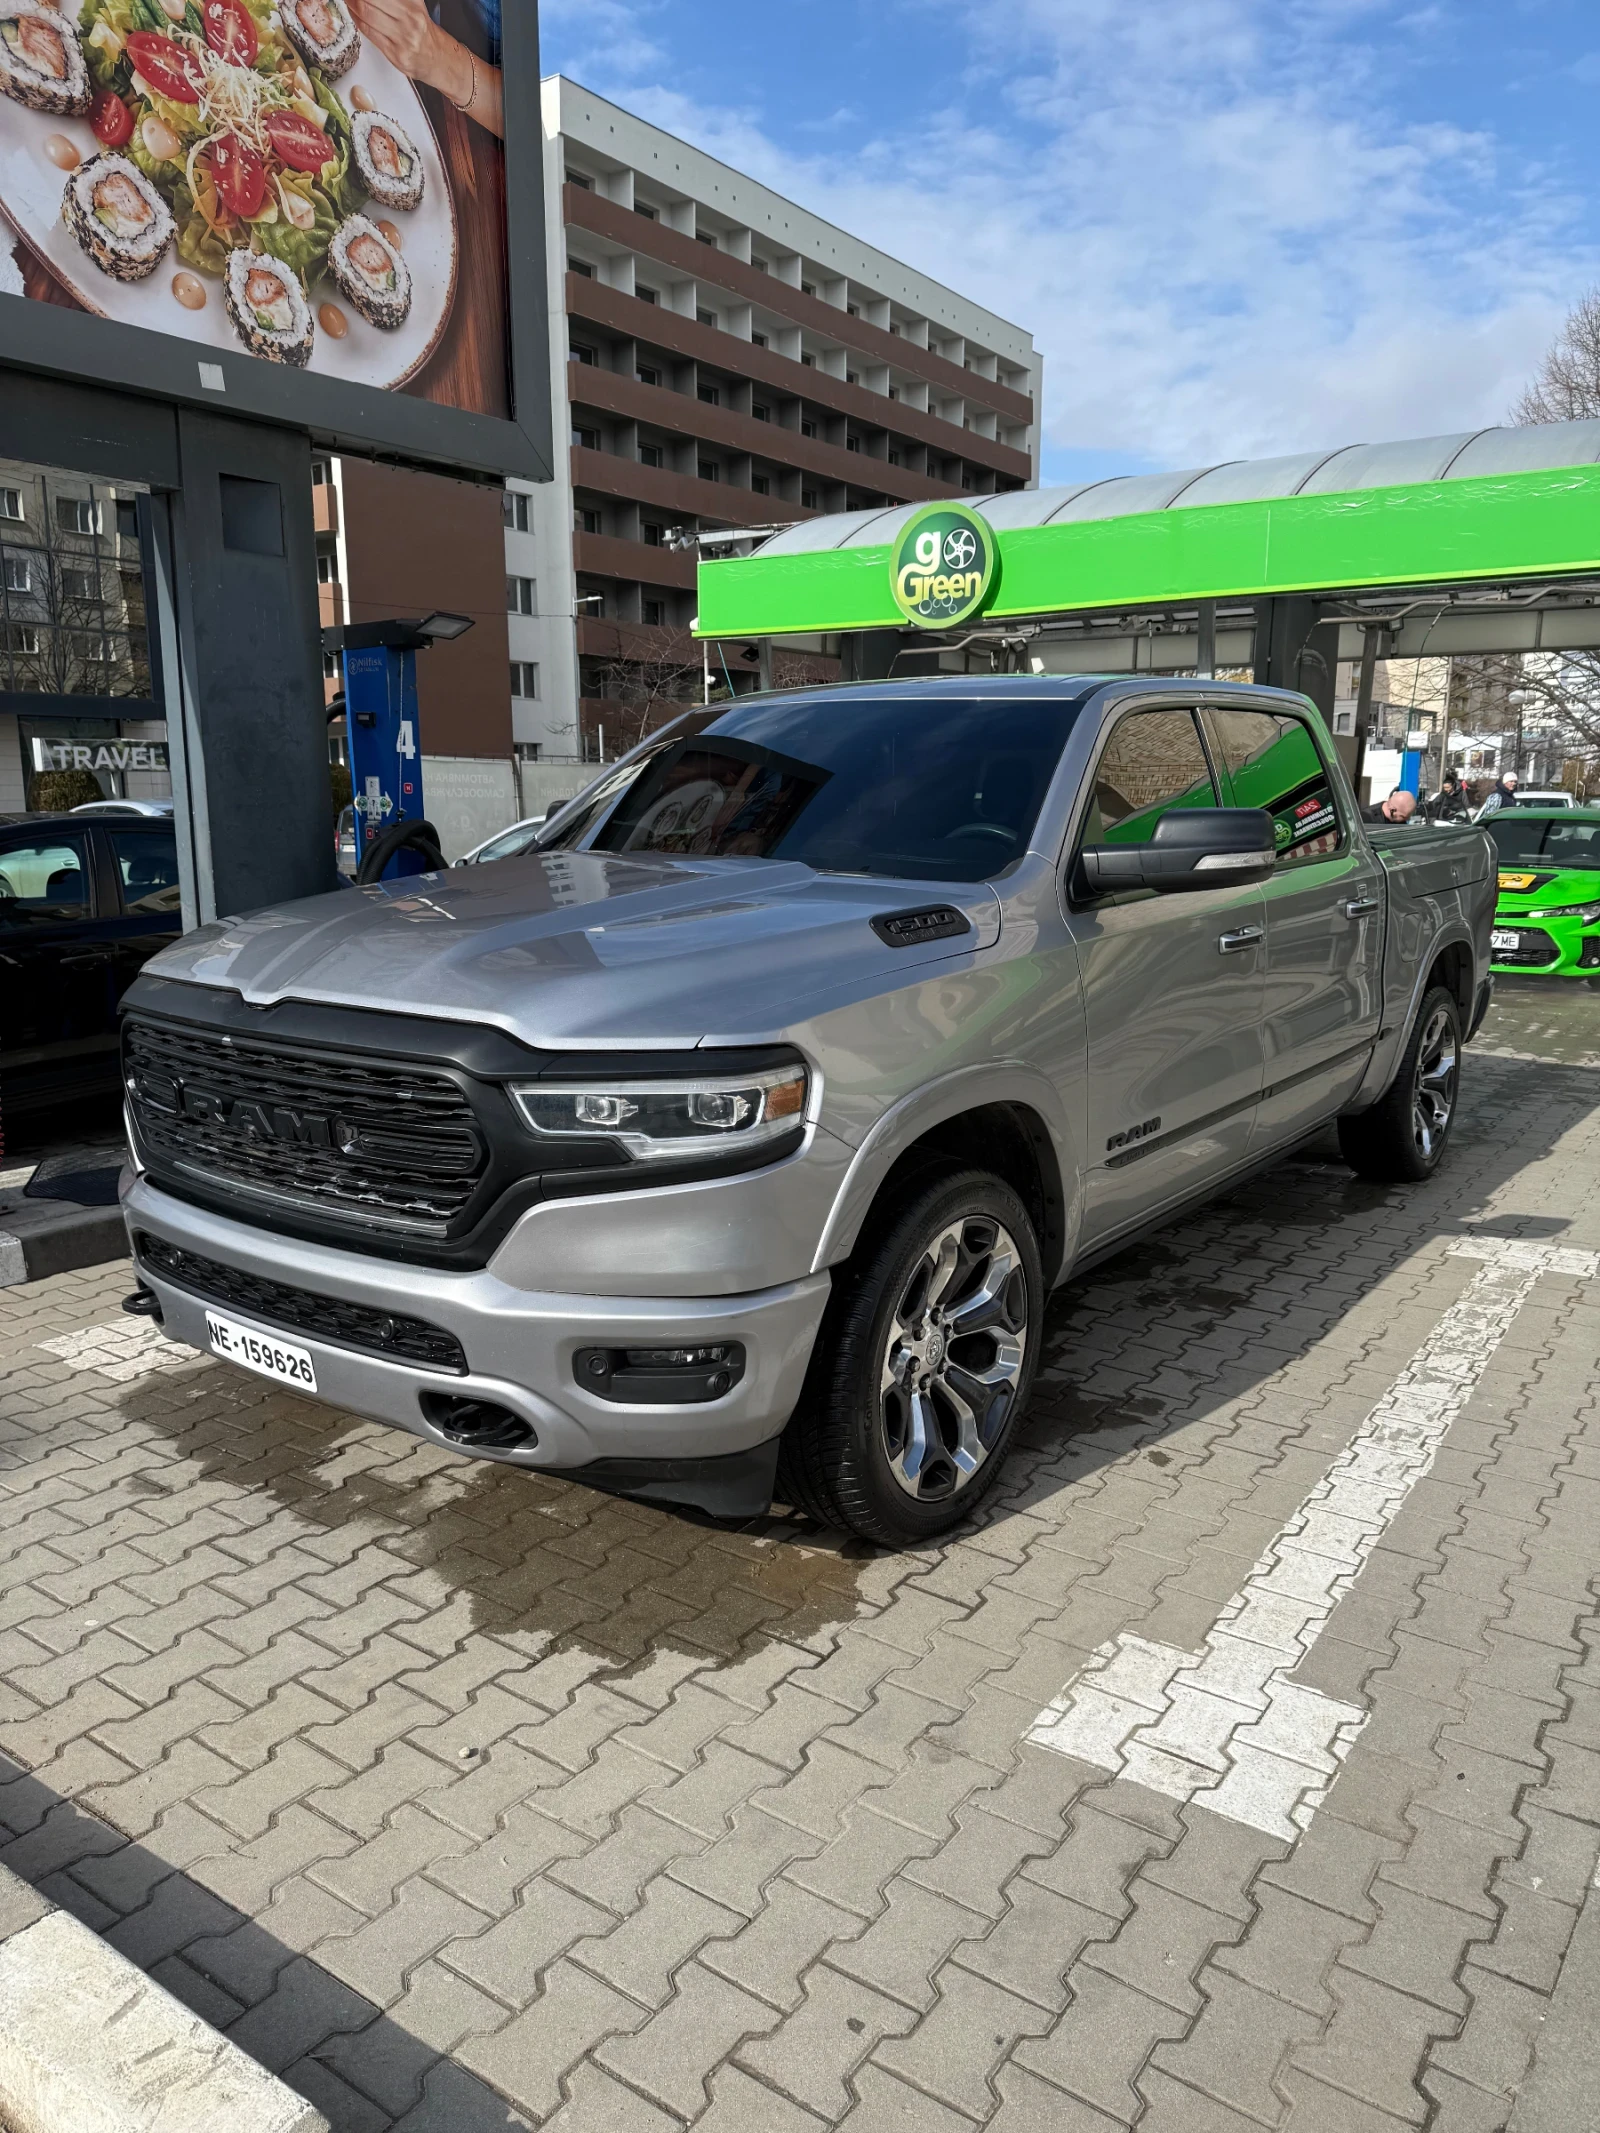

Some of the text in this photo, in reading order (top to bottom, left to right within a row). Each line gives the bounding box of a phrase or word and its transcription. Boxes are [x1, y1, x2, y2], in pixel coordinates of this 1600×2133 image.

[897, 563, 982, 606] Green
[357, 657, 383, 668] Nilfisk
[396, 720, 416, 760] 4
[52, 745, 168, 771] TRAVEL
[885, 911, 955, 934] 1500
[1500, 935, 1516, 947] ME
[183, 1085, 330, 1147] RAM
[1106, 1116, 1162, 1151] RAM
